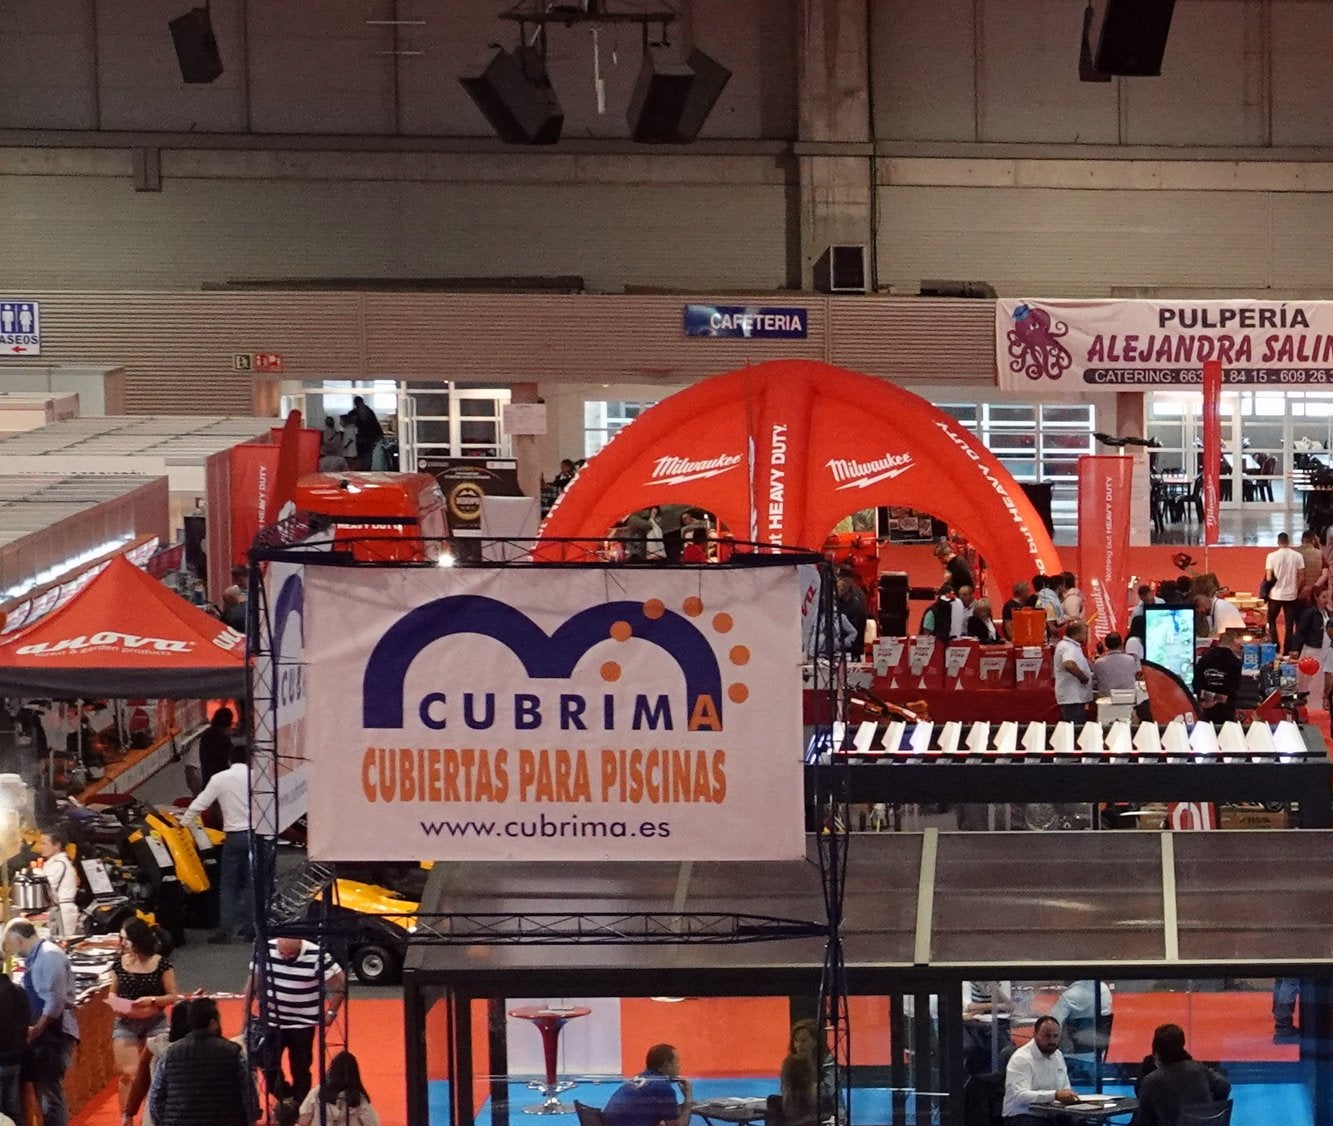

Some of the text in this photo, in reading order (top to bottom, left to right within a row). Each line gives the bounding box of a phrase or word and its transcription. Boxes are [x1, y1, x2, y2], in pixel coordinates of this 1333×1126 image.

[710, 313, 802, 332] CAFETERIA
[1158, 304, 1310, 329] PULPERÍA
[1086, 334, 1252, 363] ALEJANDRA
[1095, 370, 1175, 383] CATERING:
[1180, 370, 1204, 383] 663
[1230, 370, 1247, 383] 84
[1251, 370, 1267, 383] 15
[1280, 370, 1305, 383] 609
[1309, 370, 1327, 383] 26
[650, 453, 743, 479] Milwaukee
[825, 451, 914, 483] Milwaukee
[768, 469, 786, 529] HEAVY
[977, 463, 1024, 523] HEAVY
[15, 630, 193, 656] anova
[419, 692, 724, 732] CUBRIMA
[362, 747, 728, 804] CUBIERTAS PARA PISCINAS
[420, 814, 671, 838] www.cubrima.es
